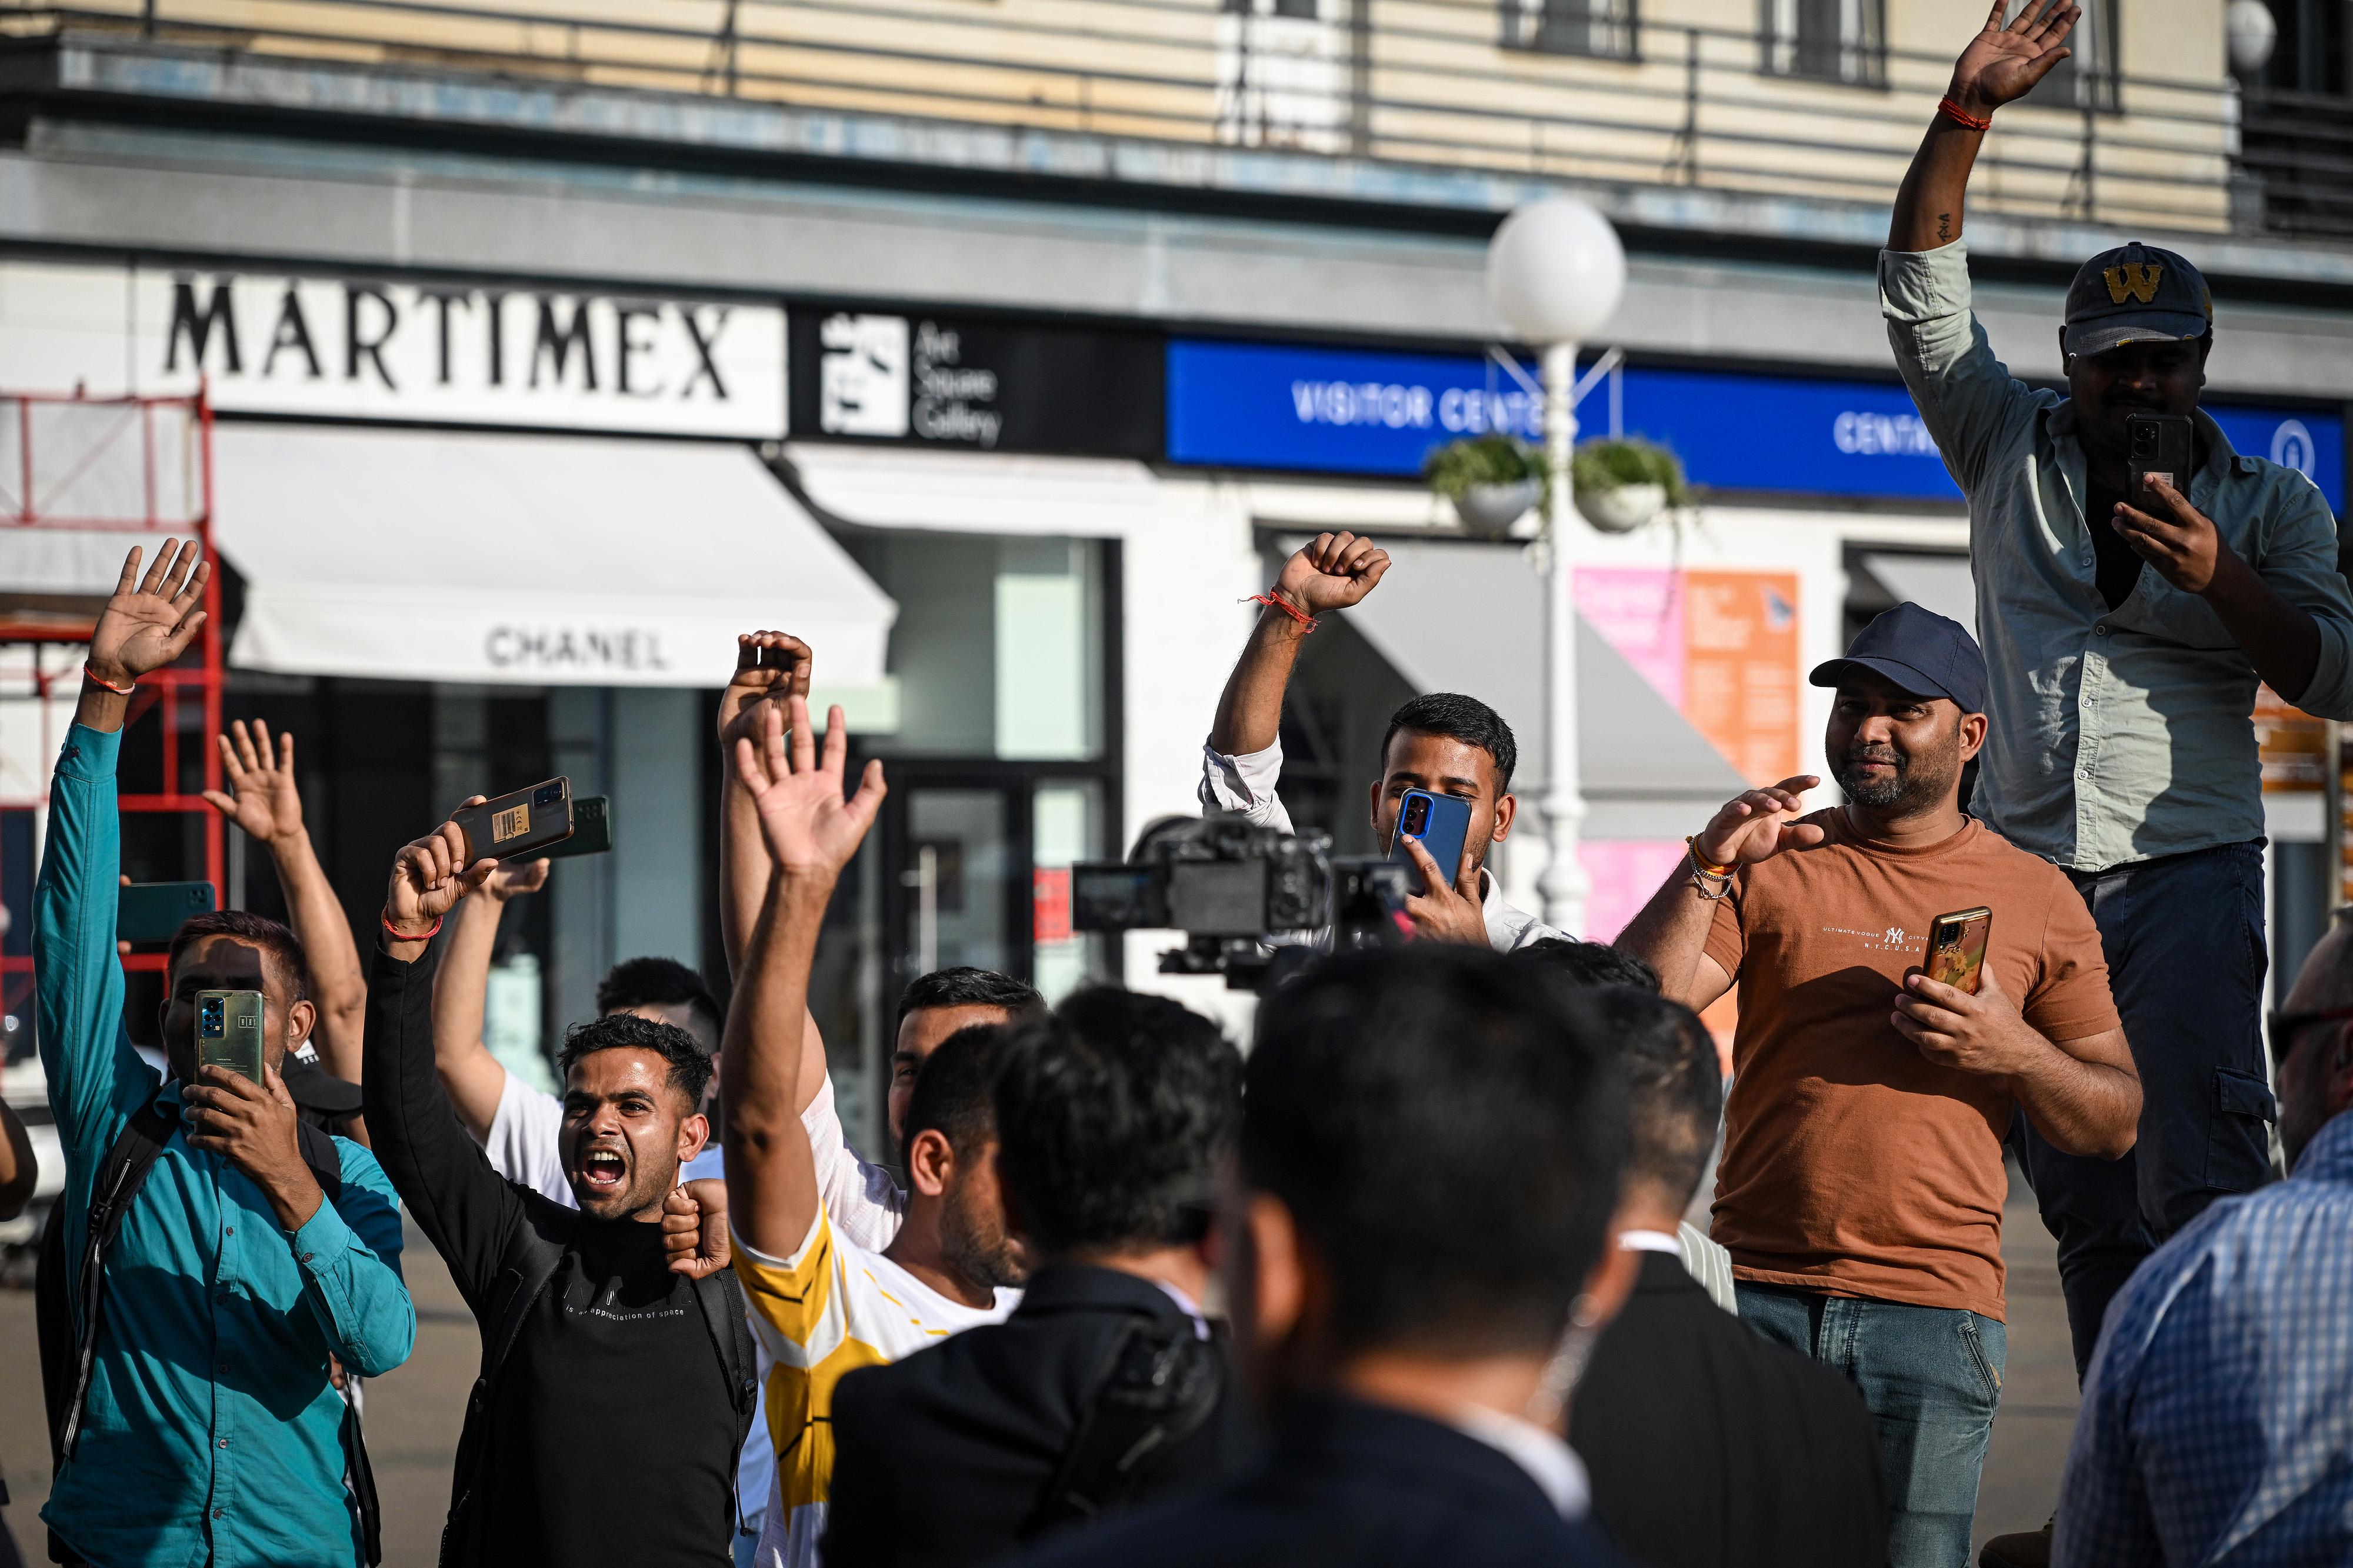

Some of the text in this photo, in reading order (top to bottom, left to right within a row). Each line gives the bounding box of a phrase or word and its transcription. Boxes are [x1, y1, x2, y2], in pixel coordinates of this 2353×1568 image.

[2104, 262, 2164, 304] W
[165, 281, 729, 399] MARTIMEX
[1291, 379, 1545, 436] VISITOR CENTE
[484, 625, 672, 672] CHANEL
[566, 1304, 574, 1312] is
[590, 1308, 642, 1321] appreciation
[659, 1309, 684, 1317] space
